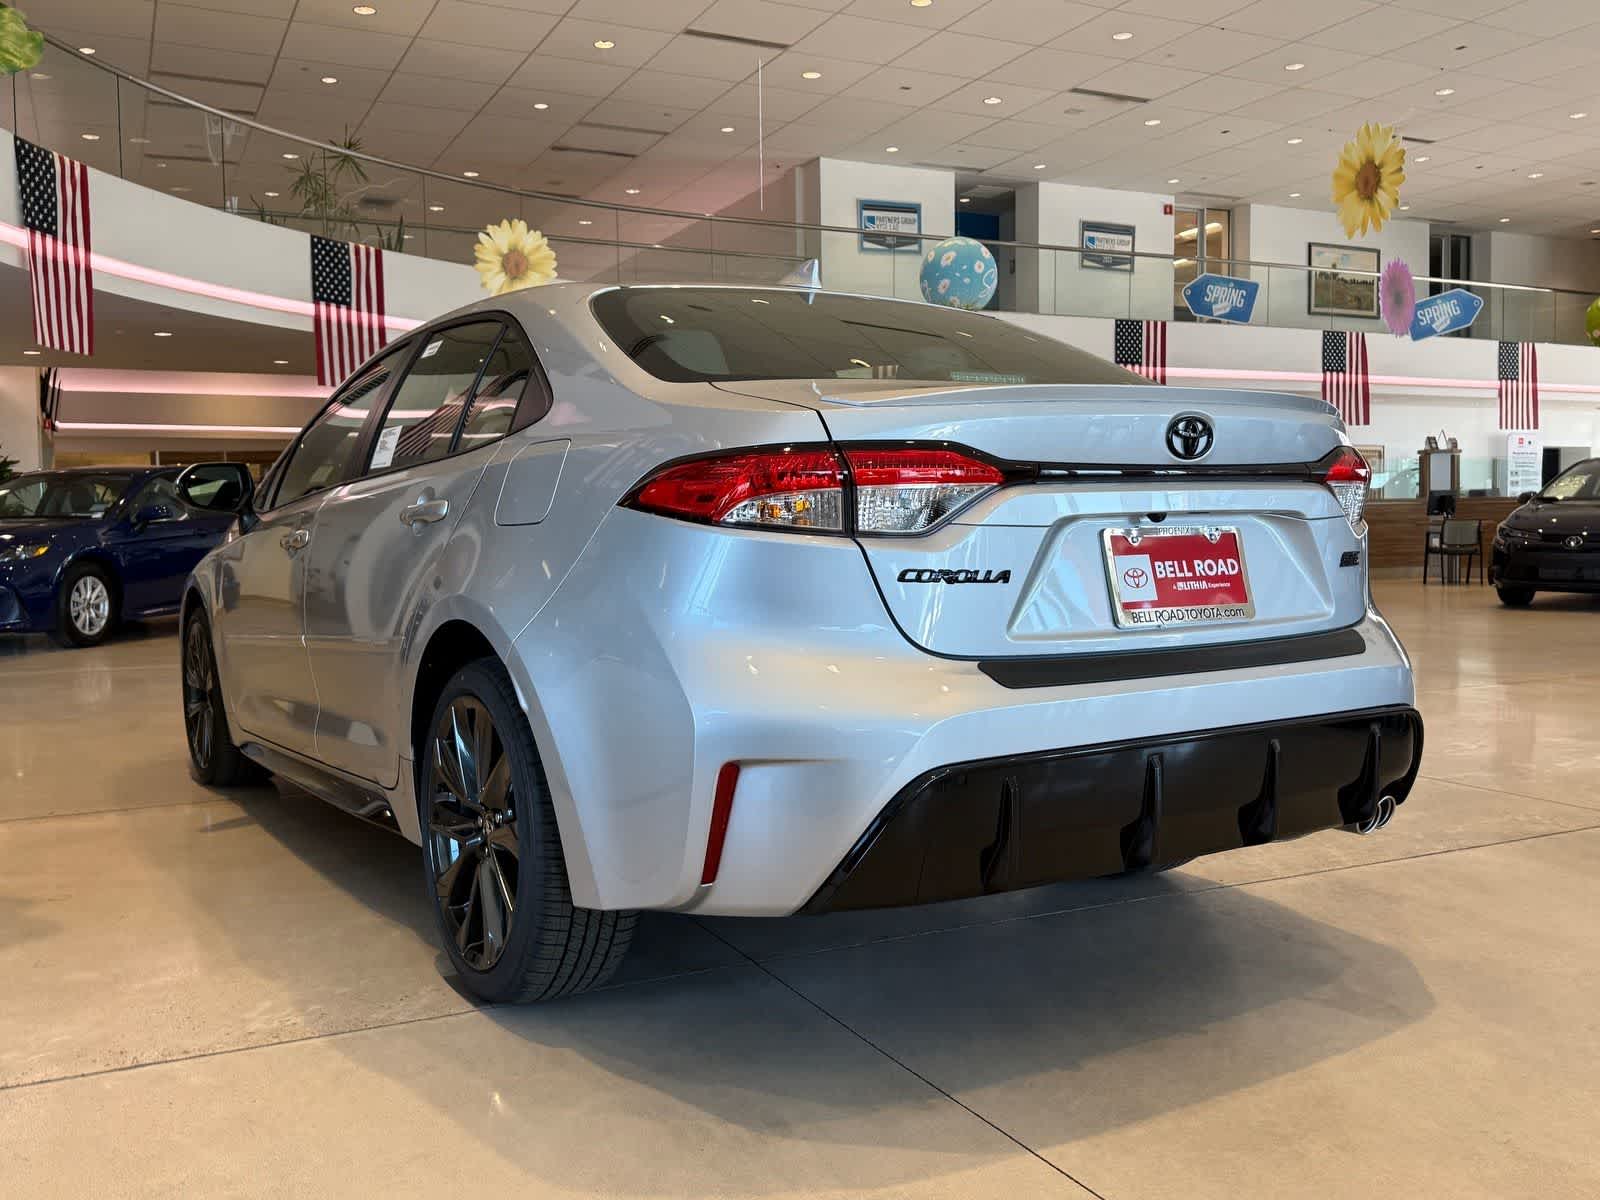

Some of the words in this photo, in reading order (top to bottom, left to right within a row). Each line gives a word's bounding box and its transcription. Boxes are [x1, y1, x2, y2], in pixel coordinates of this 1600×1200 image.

[1204, 283, 1246, 308] SPRING
[1417, 299, 1461, 326] SPRING
[897, 568, 1011, 585] COROLLA
[1154, 560, 1193, 579] BELL
[1194, 558, 1239, 576] ROAD
